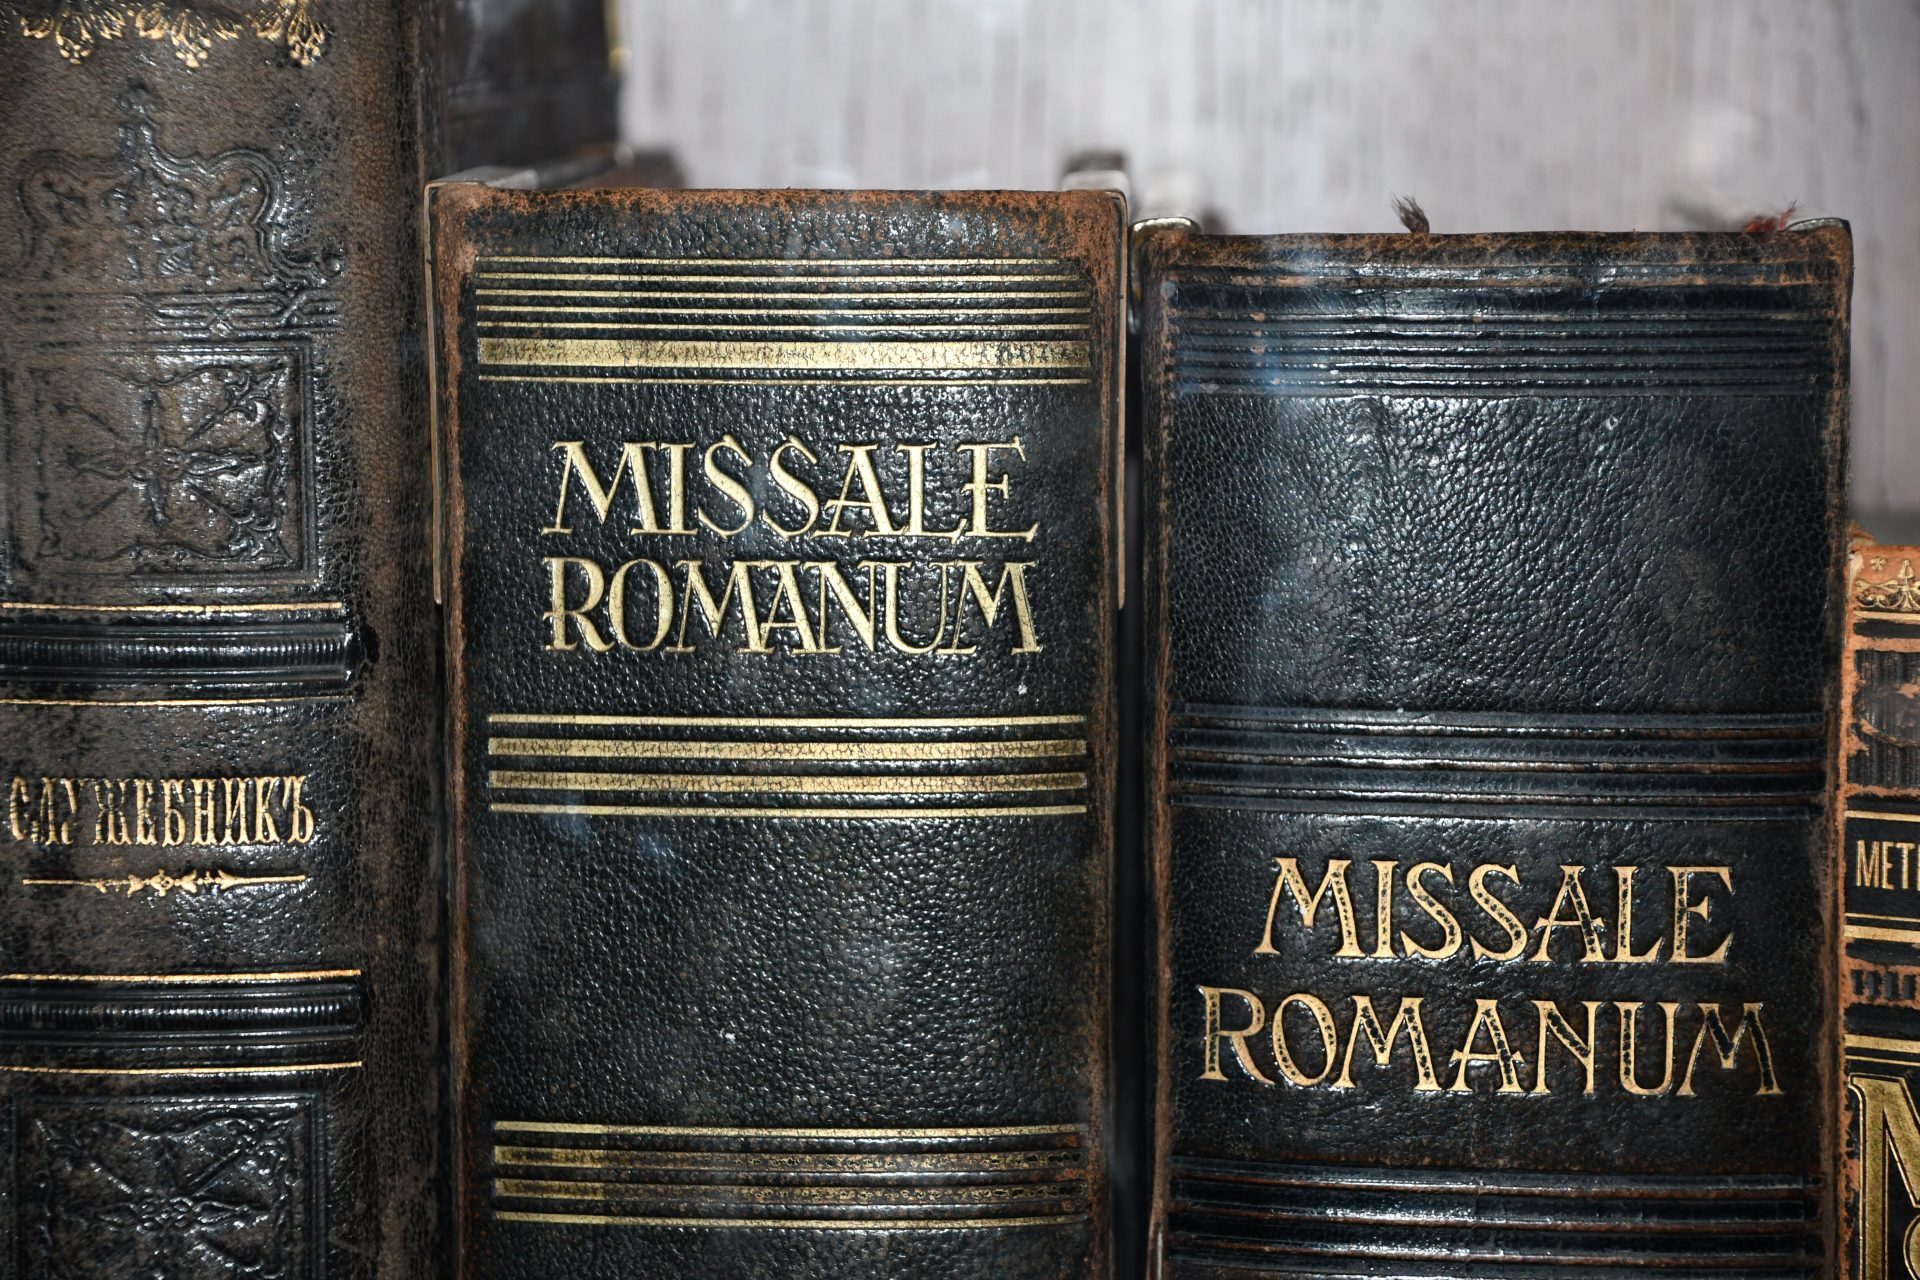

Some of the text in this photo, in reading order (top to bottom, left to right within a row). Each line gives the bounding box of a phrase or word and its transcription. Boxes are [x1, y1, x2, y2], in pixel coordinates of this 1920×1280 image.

[542, 434, 1039, 544] MISSALE
[542, 556, 1044, 655] ROMANUM
[1253, 857, 1735, 964] MISSALE
[1855, 839, 1920, 891] MET
[1198, 984, 1784, 1098] ROMANUM
